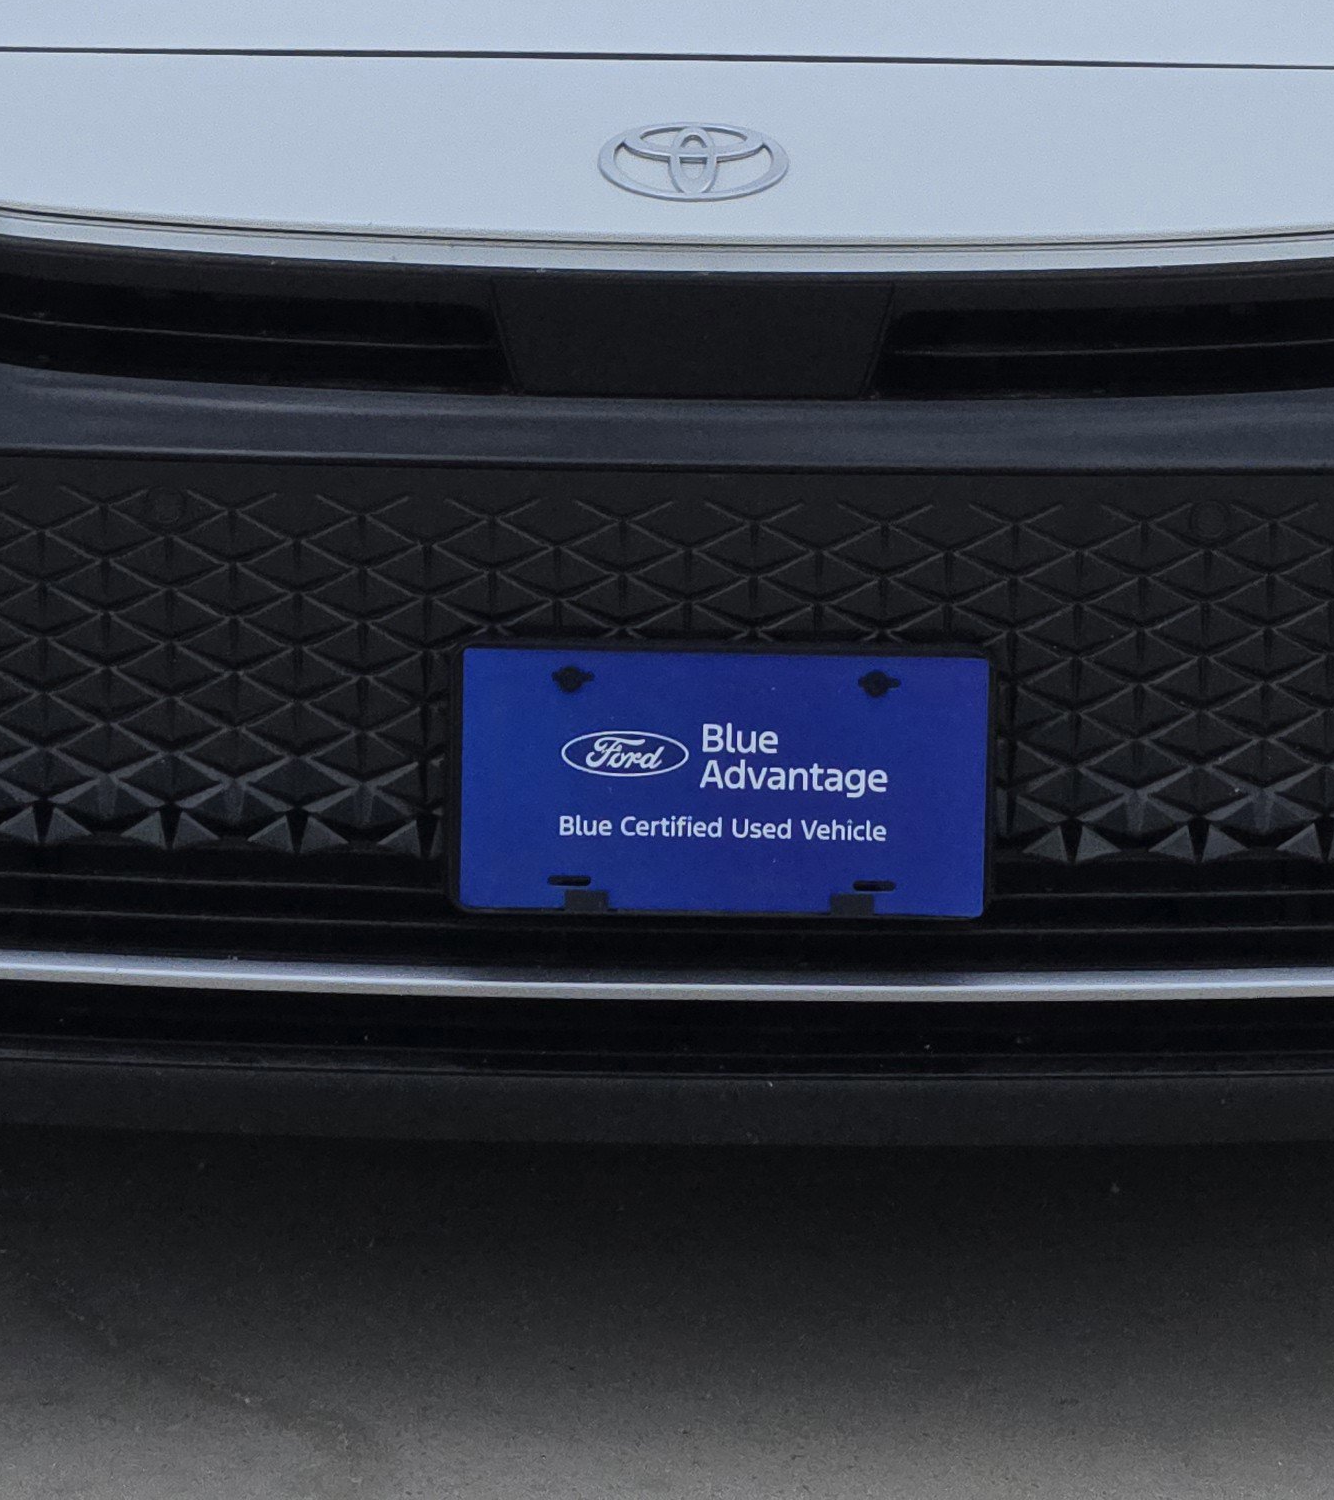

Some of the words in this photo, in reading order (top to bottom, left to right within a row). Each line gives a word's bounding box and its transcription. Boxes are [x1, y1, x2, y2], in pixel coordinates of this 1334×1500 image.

[585, 736, 665, 770] Ford
[701, 722, 779, 754] Blue
[699, 759, 889, 798] Advantage
[558, 815, 613, 836] Blue
[620, 815, 723, 838] Certified
[731, 817, 792, 840] Used
[800, 819, 887, 842] Vehicle
